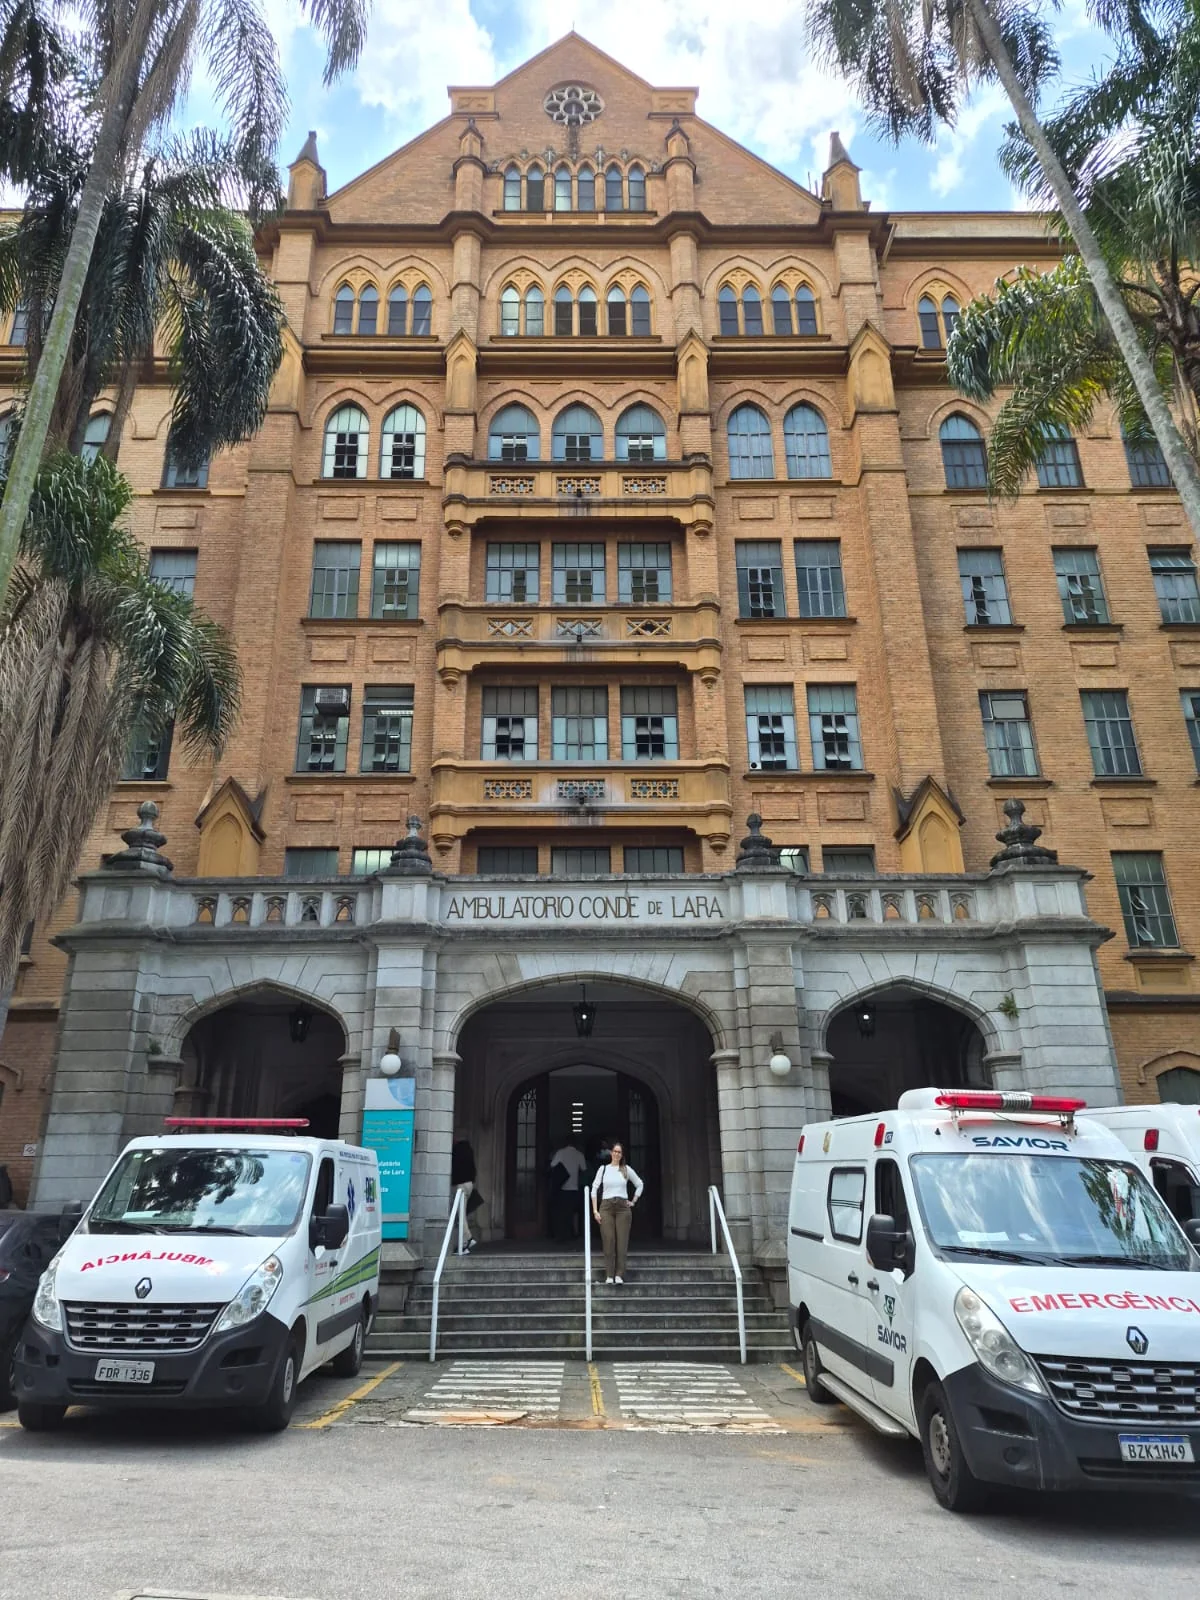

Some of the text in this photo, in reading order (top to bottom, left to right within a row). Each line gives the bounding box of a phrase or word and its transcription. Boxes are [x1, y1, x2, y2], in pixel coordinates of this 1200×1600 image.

[446, 896, 725, 919] AMBULATORIO CONDE DE LARA
[971, 1136, 1071, 1152] SAVIOR
[877, 1324, 908, 1355] SAVIOR
[98, 1367, 120, 1378] FDR
[1127, 1444, 1186, 1460] BZK1H49
